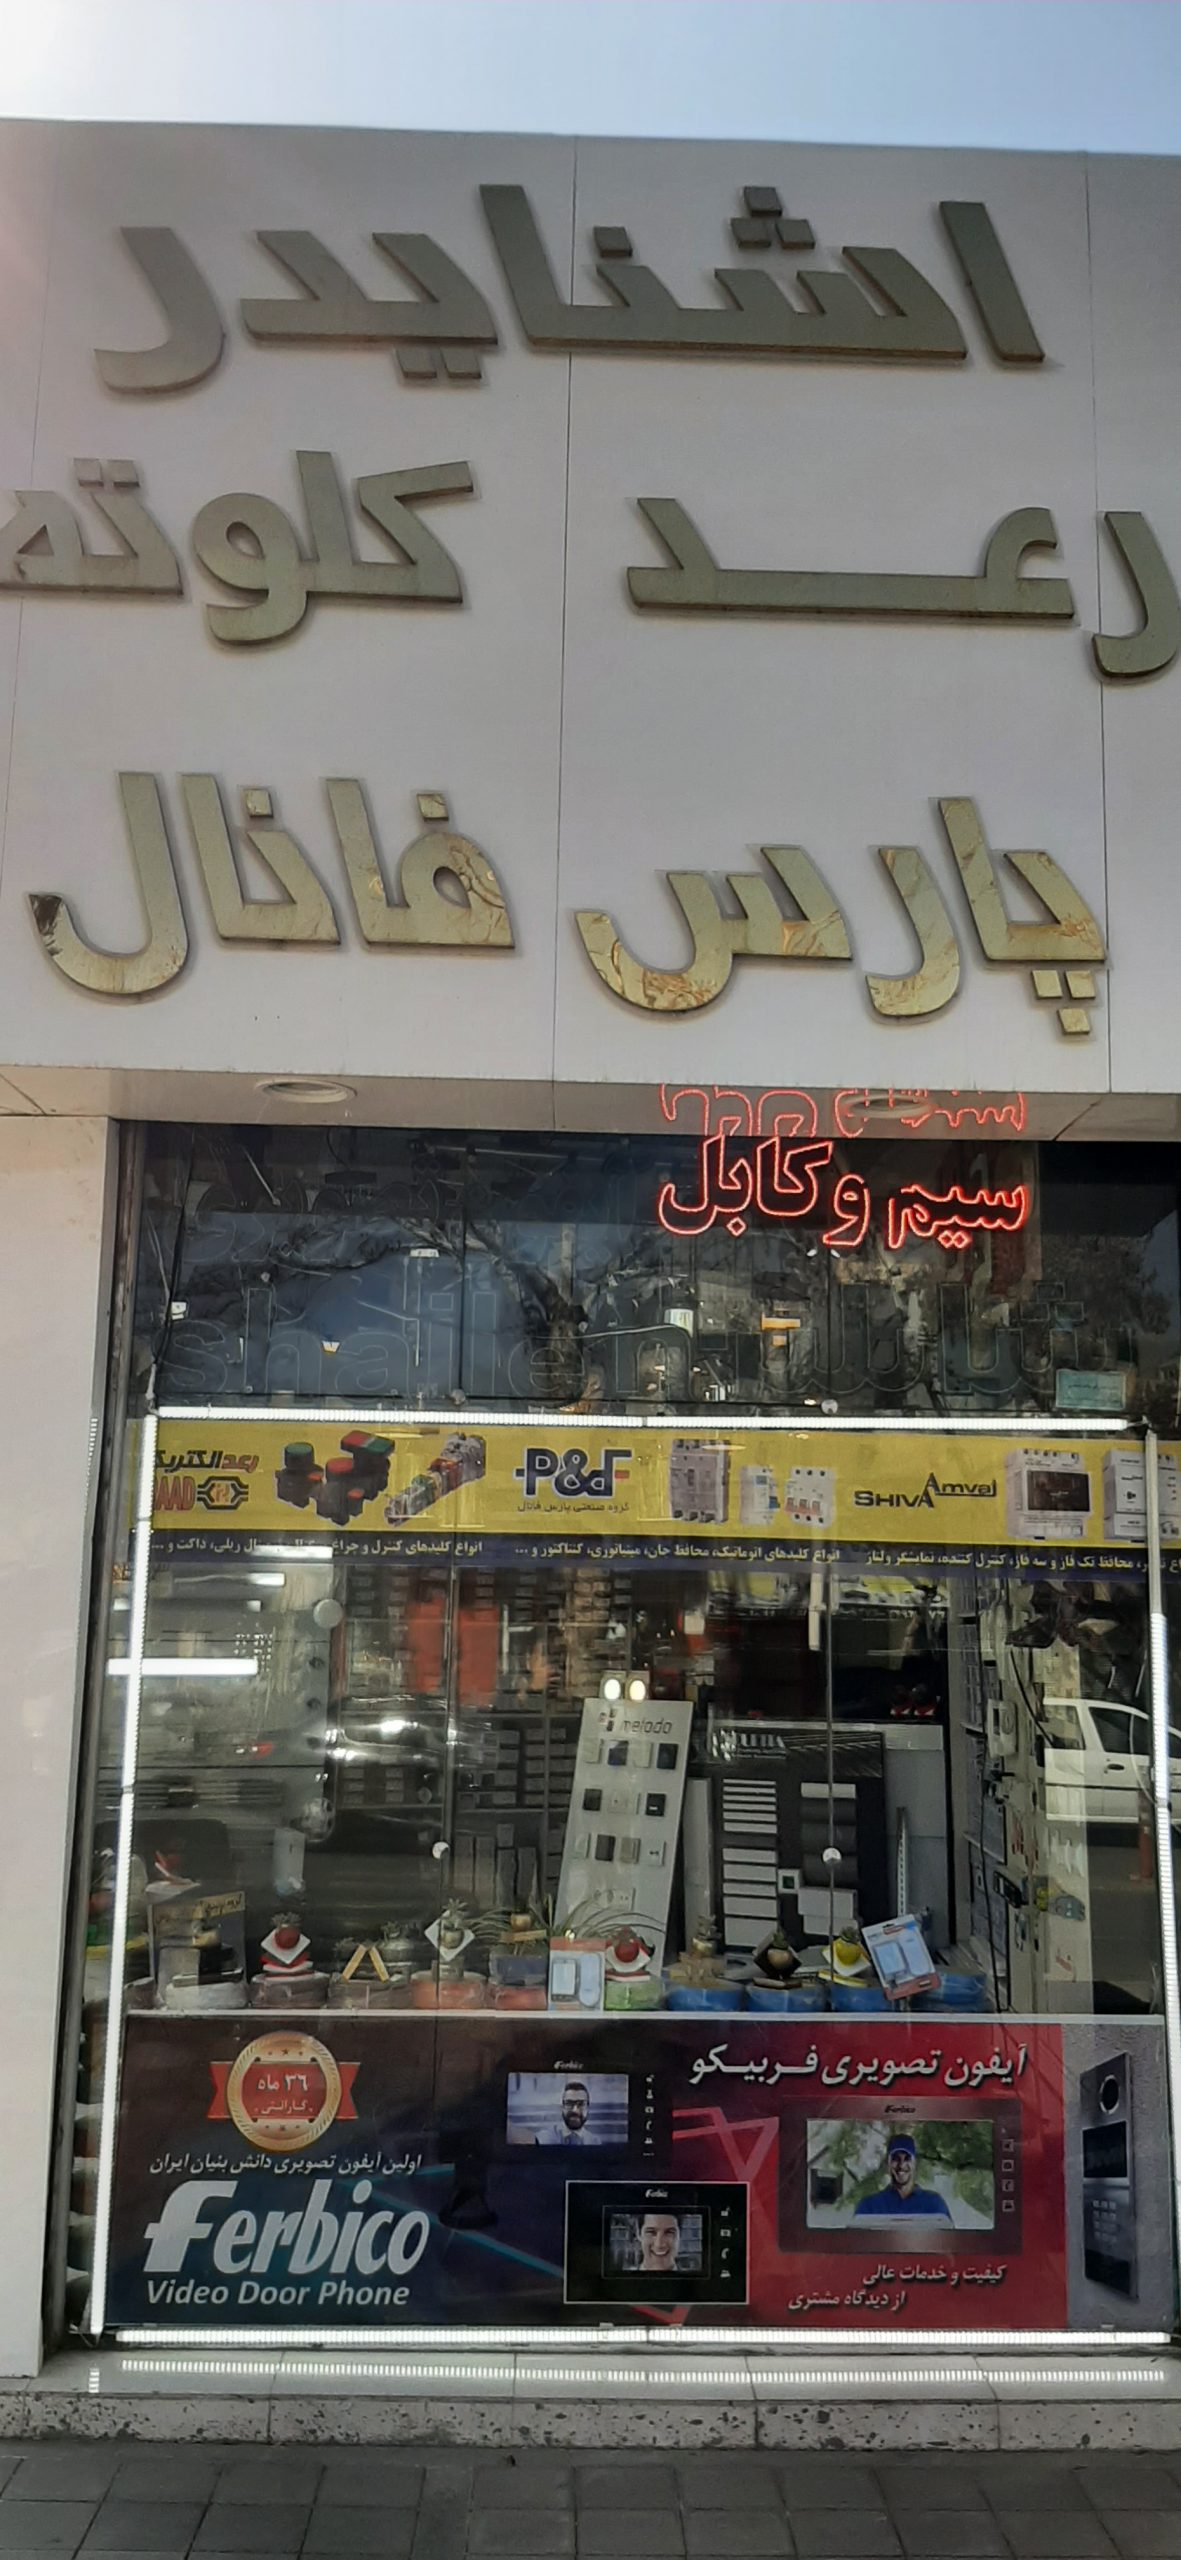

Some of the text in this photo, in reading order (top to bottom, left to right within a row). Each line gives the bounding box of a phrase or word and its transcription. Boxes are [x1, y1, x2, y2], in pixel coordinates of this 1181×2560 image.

[95, 184, 1046, 393] اشنایدر
[627, 498, 1181, 681] رعد
[29, 771, 1107, 1035] پارس فانال
[658, 1134, 834, 1238] کابل
[821, 1172, 870, 1248] و
[886, 1183, 1029, 1250] سیم
[371, 1539, 403, 1555] کنترل
[405, 1538, 451, 1555] کلیدهای
[454, 1540, 482, 1557] انواع
[673, 1543, 709, 1558] محافظ
[764, 1546, 810, 1562] کلیدهای
[812, 1548, 840, 1565] انواع
[975, 1553, 1007, 1569] کنترل
[688, 2042, 1029, 2087] آیفون تصویری فربیکو
[257, 2073, 280, 2091] ماه
[149, 2152, 421, 2175] اولین آیفون تصویری دانش بنیان ایران
[862, 2263, 1008, 2286] کیفیت و خدمات عالی
[147, 2279, 411, 2306] Video Door Phone
[788, 2290, 841, 2311] مشتری
[891, 2290, 906, 2311] از
